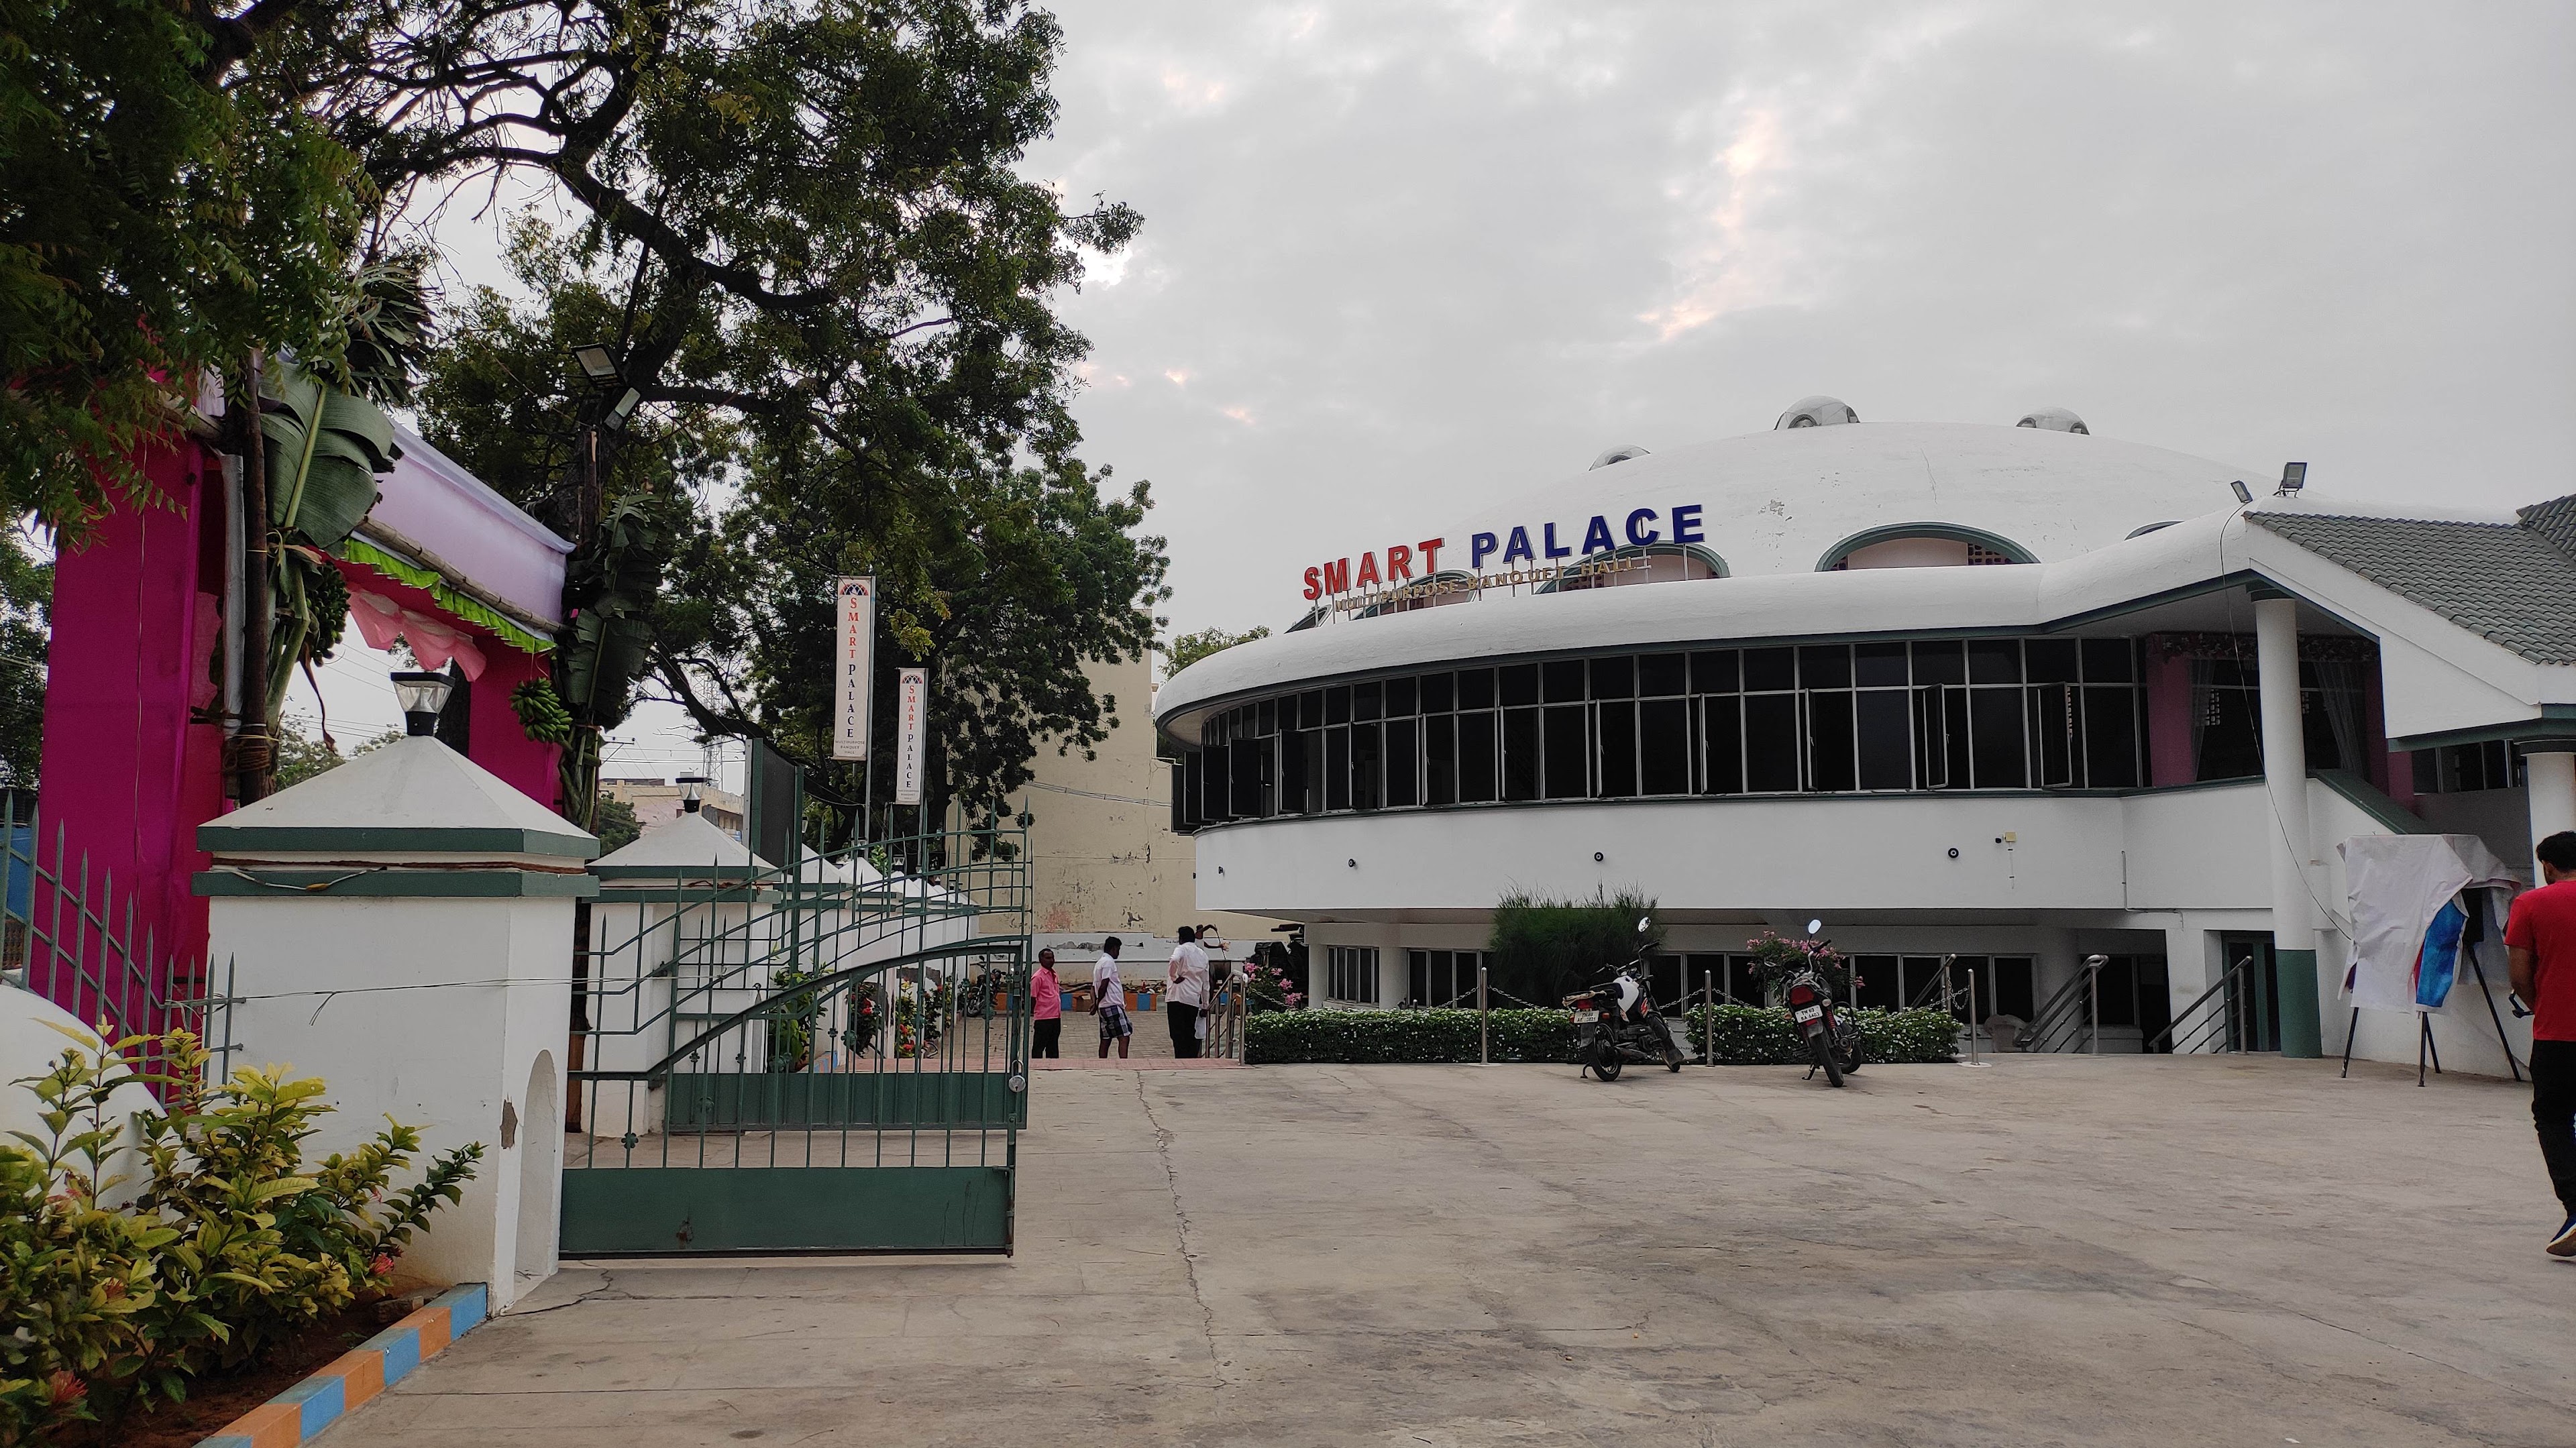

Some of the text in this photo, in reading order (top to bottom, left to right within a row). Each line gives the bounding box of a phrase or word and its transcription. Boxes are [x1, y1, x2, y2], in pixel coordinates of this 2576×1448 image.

[1303, 504, 1705, 601] SMART PALACE
[1336, 556, 1638, 612] MULTIPURPOSE BANQUET HALL
[847, 597, 859, 738] SMART PALACE
[906, 685, 916, 730] SMART
[906, 734, 914, 788] PALACE
